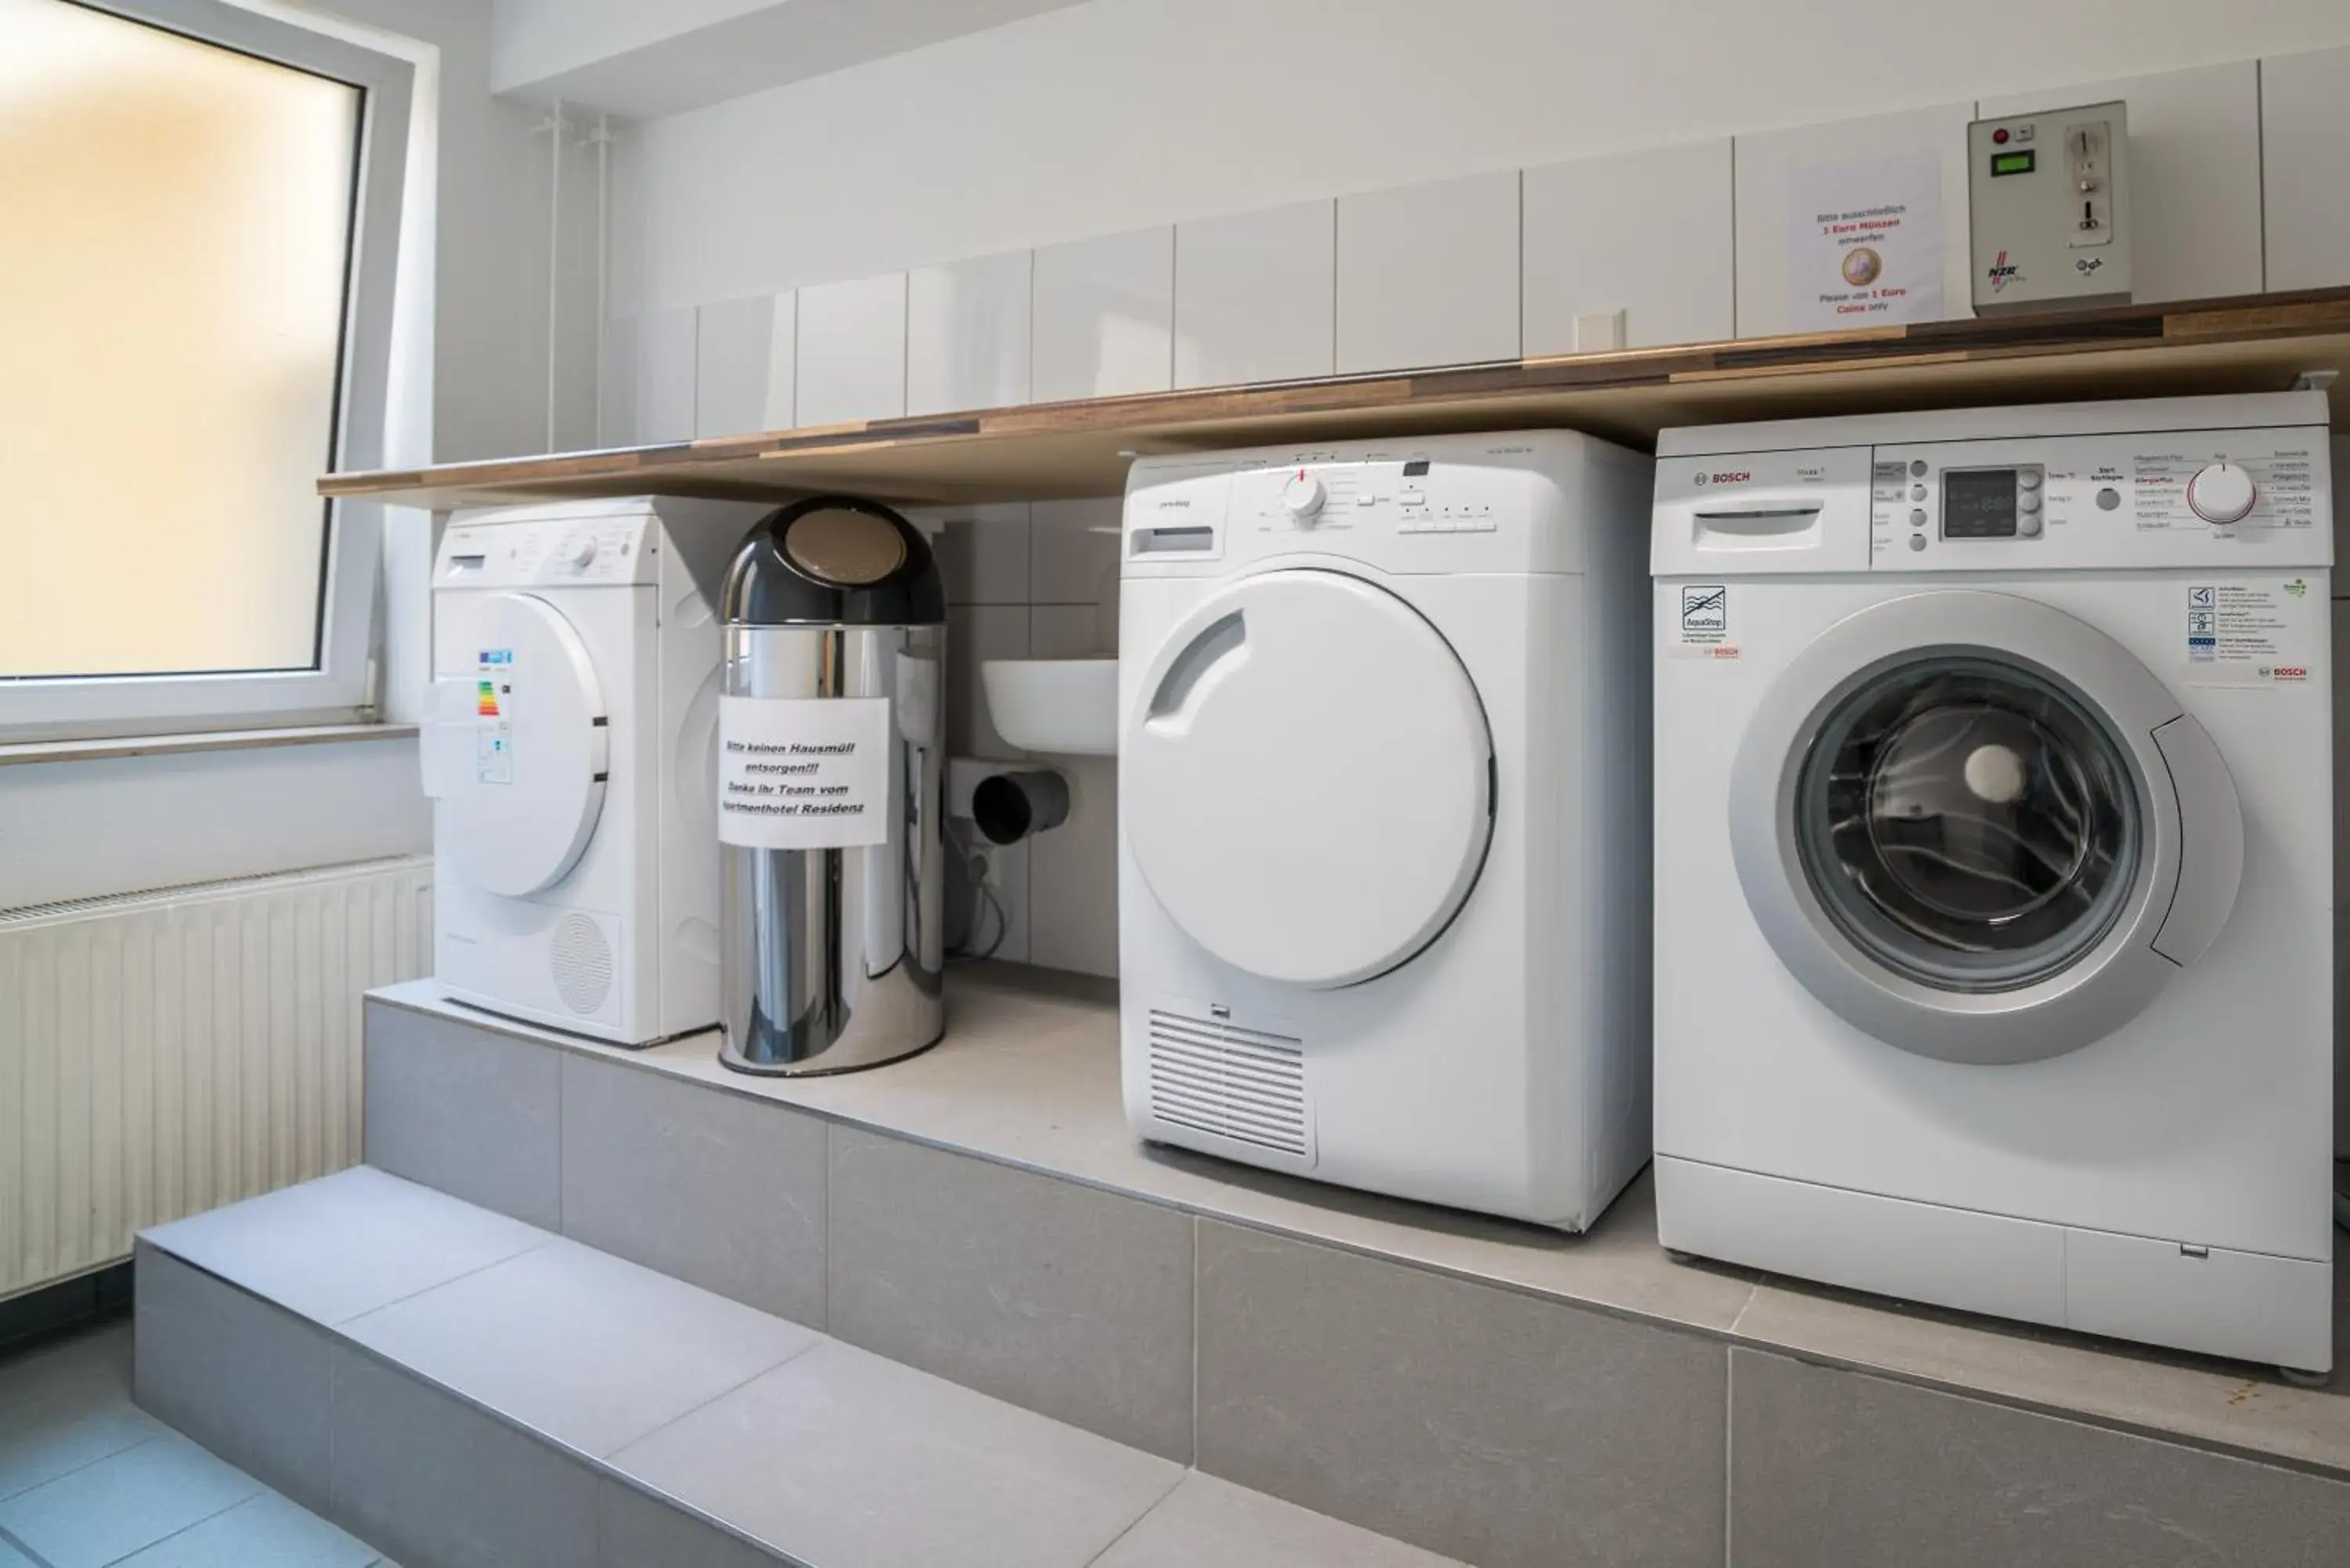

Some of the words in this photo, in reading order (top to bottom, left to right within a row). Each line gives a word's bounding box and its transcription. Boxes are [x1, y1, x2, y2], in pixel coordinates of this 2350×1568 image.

[1832, 224, 1856, 234] Euro
[1859, 218, 1900, 230] Münzen
[1881, 287, 1907, 298] Euro
[1712, 471, 1751, 483] BOSCH
[1687, 618, 1723, 627] AquaStop
[2274, 667, 2307, 677] BOSCH
[747, 741, 786, 753] keinen
[789, 742, 855, 754] Hausmüll
[746, 763, 819, 775] entsorgen!!!
[779, 784, 815, 795] Team
[819, 785, 849, 795] vom
[801, 804, 865, 815] Residenz
